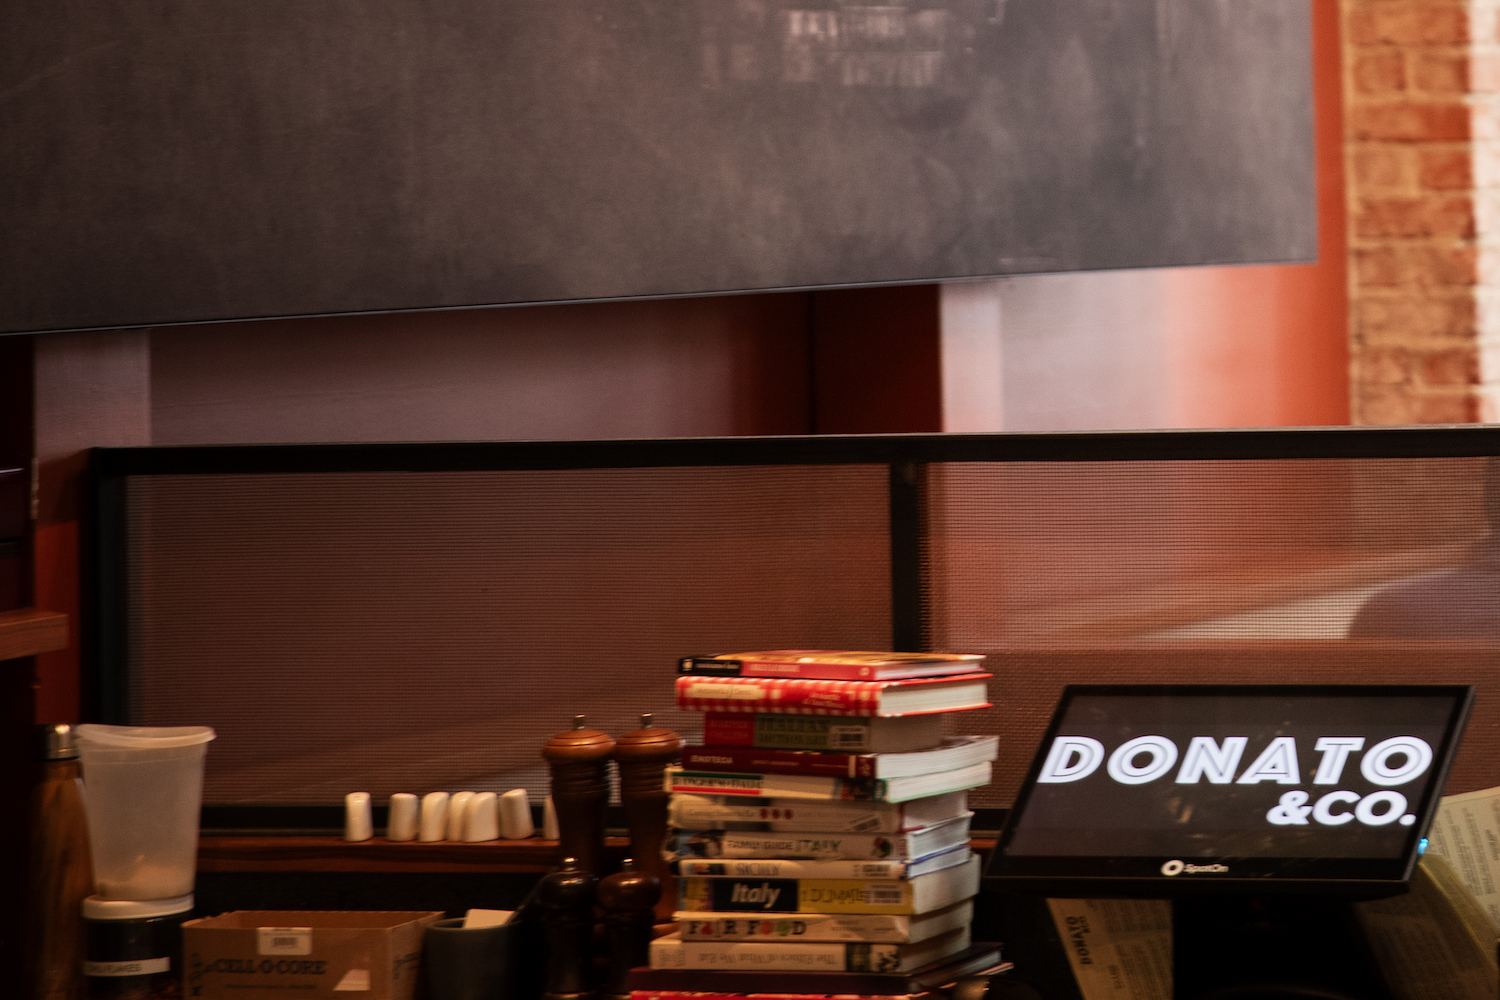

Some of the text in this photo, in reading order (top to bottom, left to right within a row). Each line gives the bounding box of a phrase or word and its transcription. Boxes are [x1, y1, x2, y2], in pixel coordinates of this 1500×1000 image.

[1037, 735, 1433, 785] DONATO
[1266, 790, 1417, 826] &CO.
[727, 839, 842, 853] FAMILY GUIDE ITALY
[731, 881, 782, 909] Italy
